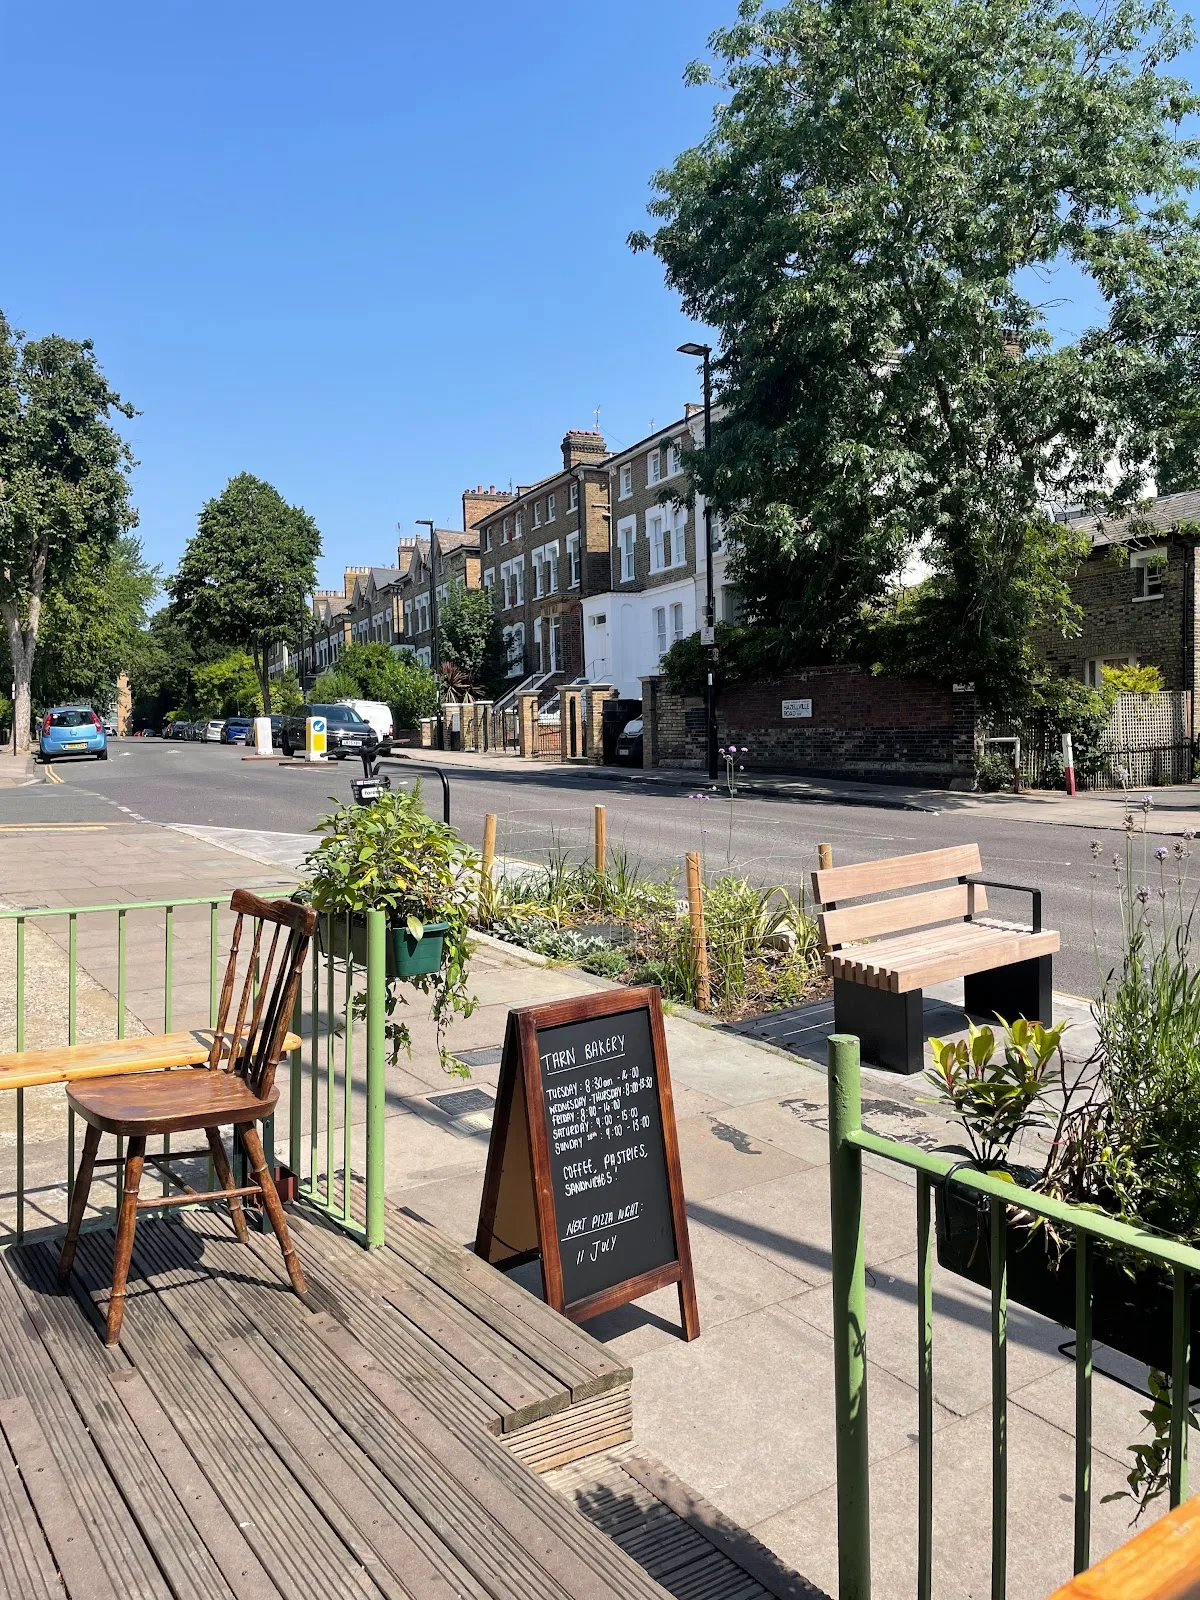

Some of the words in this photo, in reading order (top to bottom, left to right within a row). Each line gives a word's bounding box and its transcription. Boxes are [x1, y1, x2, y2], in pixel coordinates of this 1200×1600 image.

[540, 1047, 576, 1071] TARN
[584, 1034, 625, 1060] BAKERY
[549, 1095, 587, 1115] WEDNESDAY
[595, 1114, 613, 1129] 9:00
[554, 1136, 583, 1155] SUNDAY
[605, 1123, 623, 1140] 9:00
[563, 1158, 597, 1181] COFFEE,
[603, 1143, 648, 1170] PASTRIES,
[566, 1216, 588, 1237] NEXT
[591, 1211, 614, 1229] PIZZA
